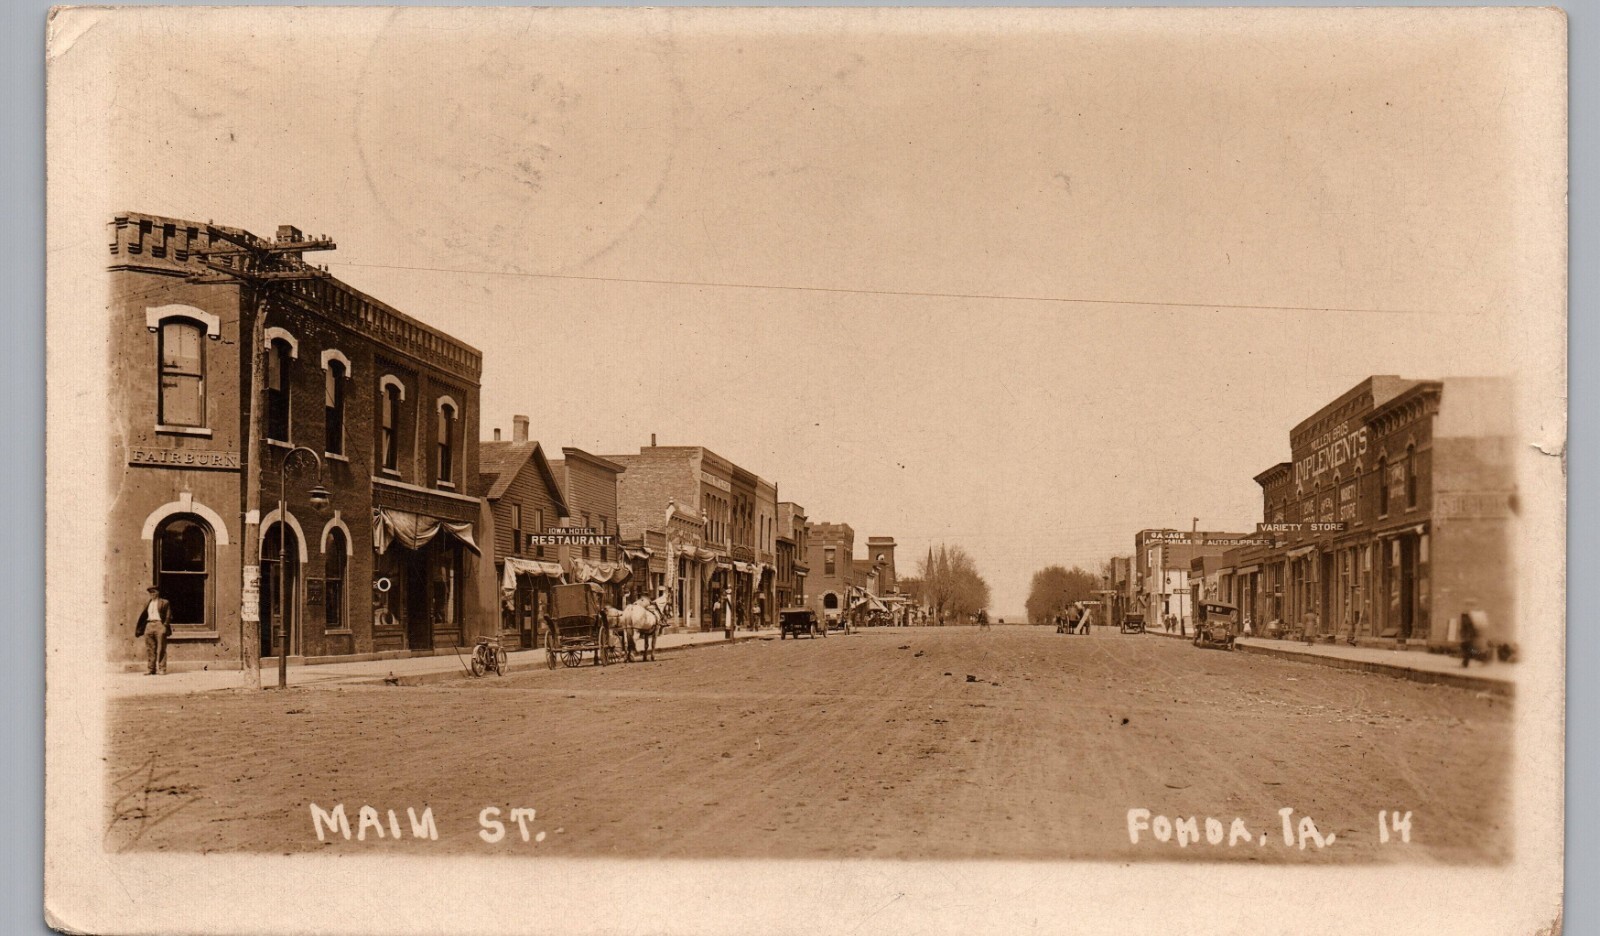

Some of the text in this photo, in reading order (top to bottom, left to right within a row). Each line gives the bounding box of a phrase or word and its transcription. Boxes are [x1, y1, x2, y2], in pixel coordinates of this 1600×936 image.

[132, 450, 237, 467] FAIRBURN
[1295, 425, 1367, 485] IMPLEMENTS
[1340, 502, 1357, 521] STORE
[548, 527, 595, 535] IOWA HOTEL
[1260, 523, 1344, 531] VARIETY STORE
[531, 535, 612, 545] RESTAURANT
